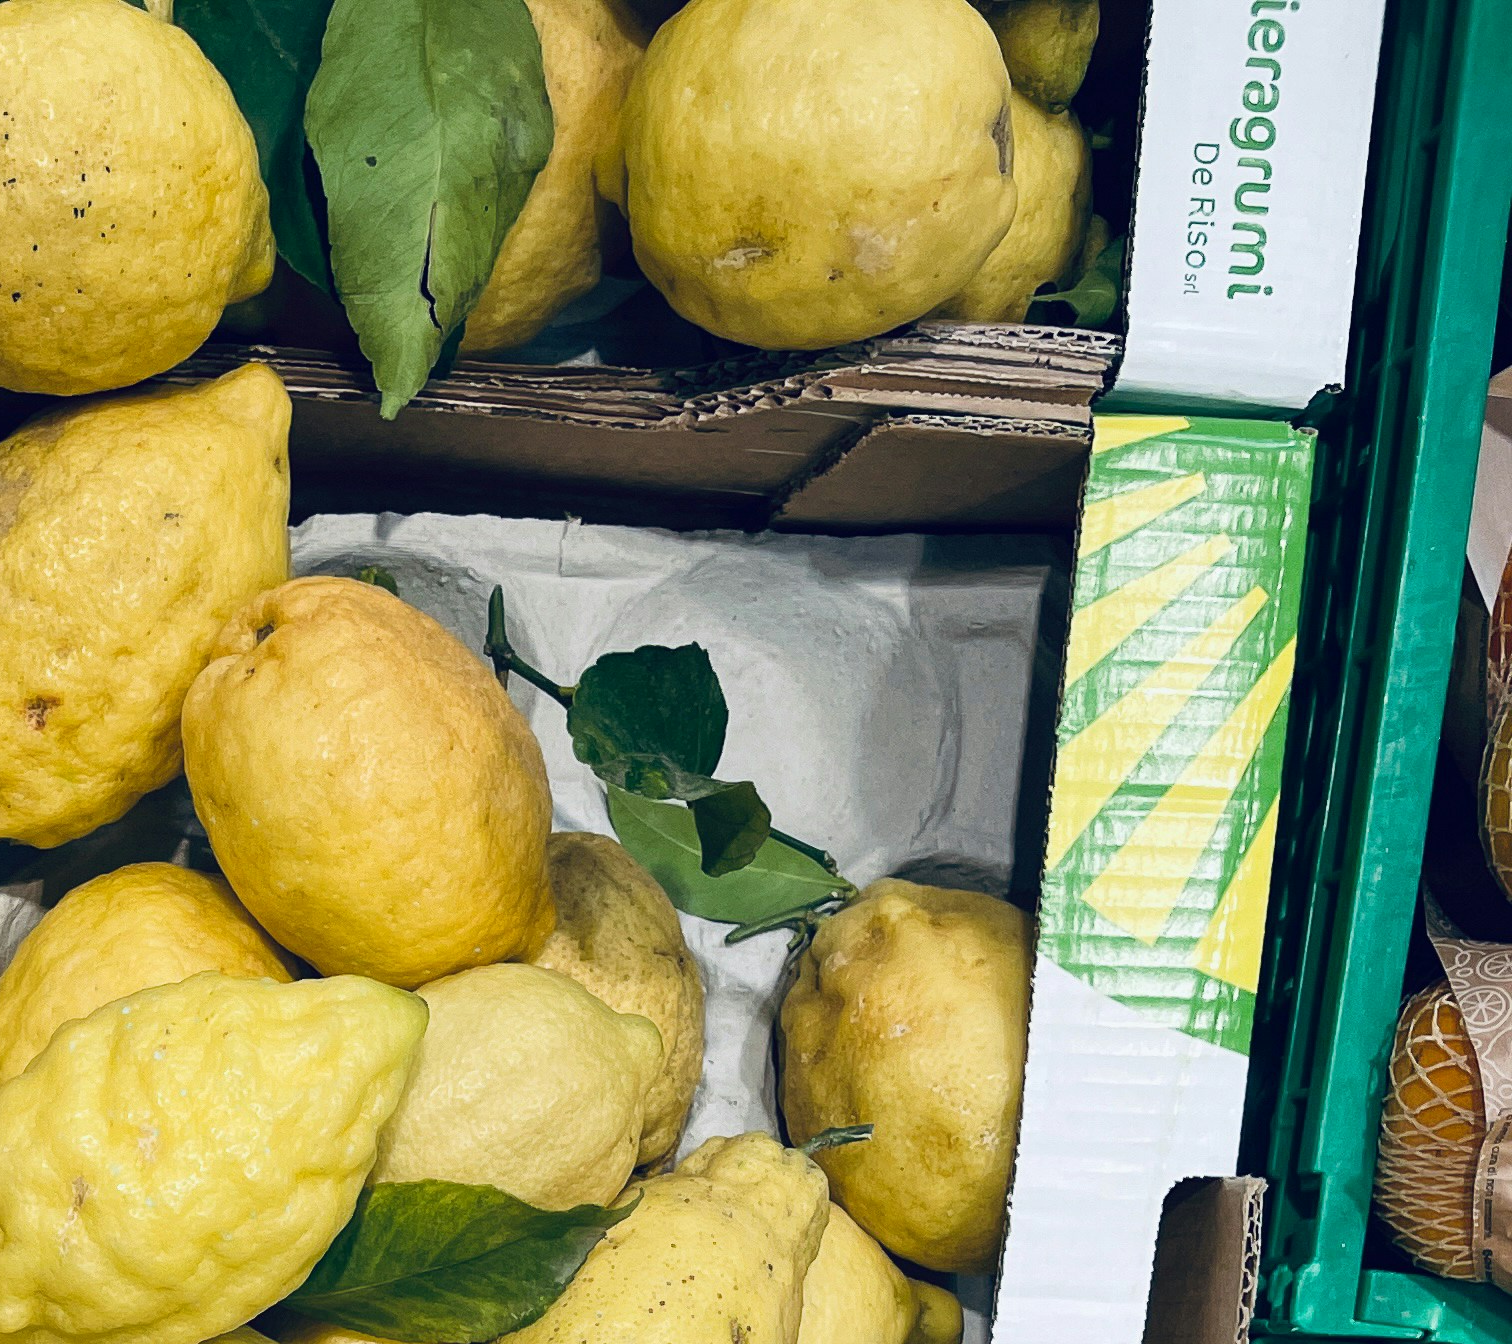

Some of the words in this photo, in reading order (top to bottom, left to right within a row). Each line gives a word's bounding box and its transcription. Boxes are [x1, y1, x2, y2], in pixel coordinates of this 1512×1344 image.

[1192, 142, 1220, 185] De
[1186, 197, 1216, 269] Riso
[1183, 273, 1199, 295] srl
